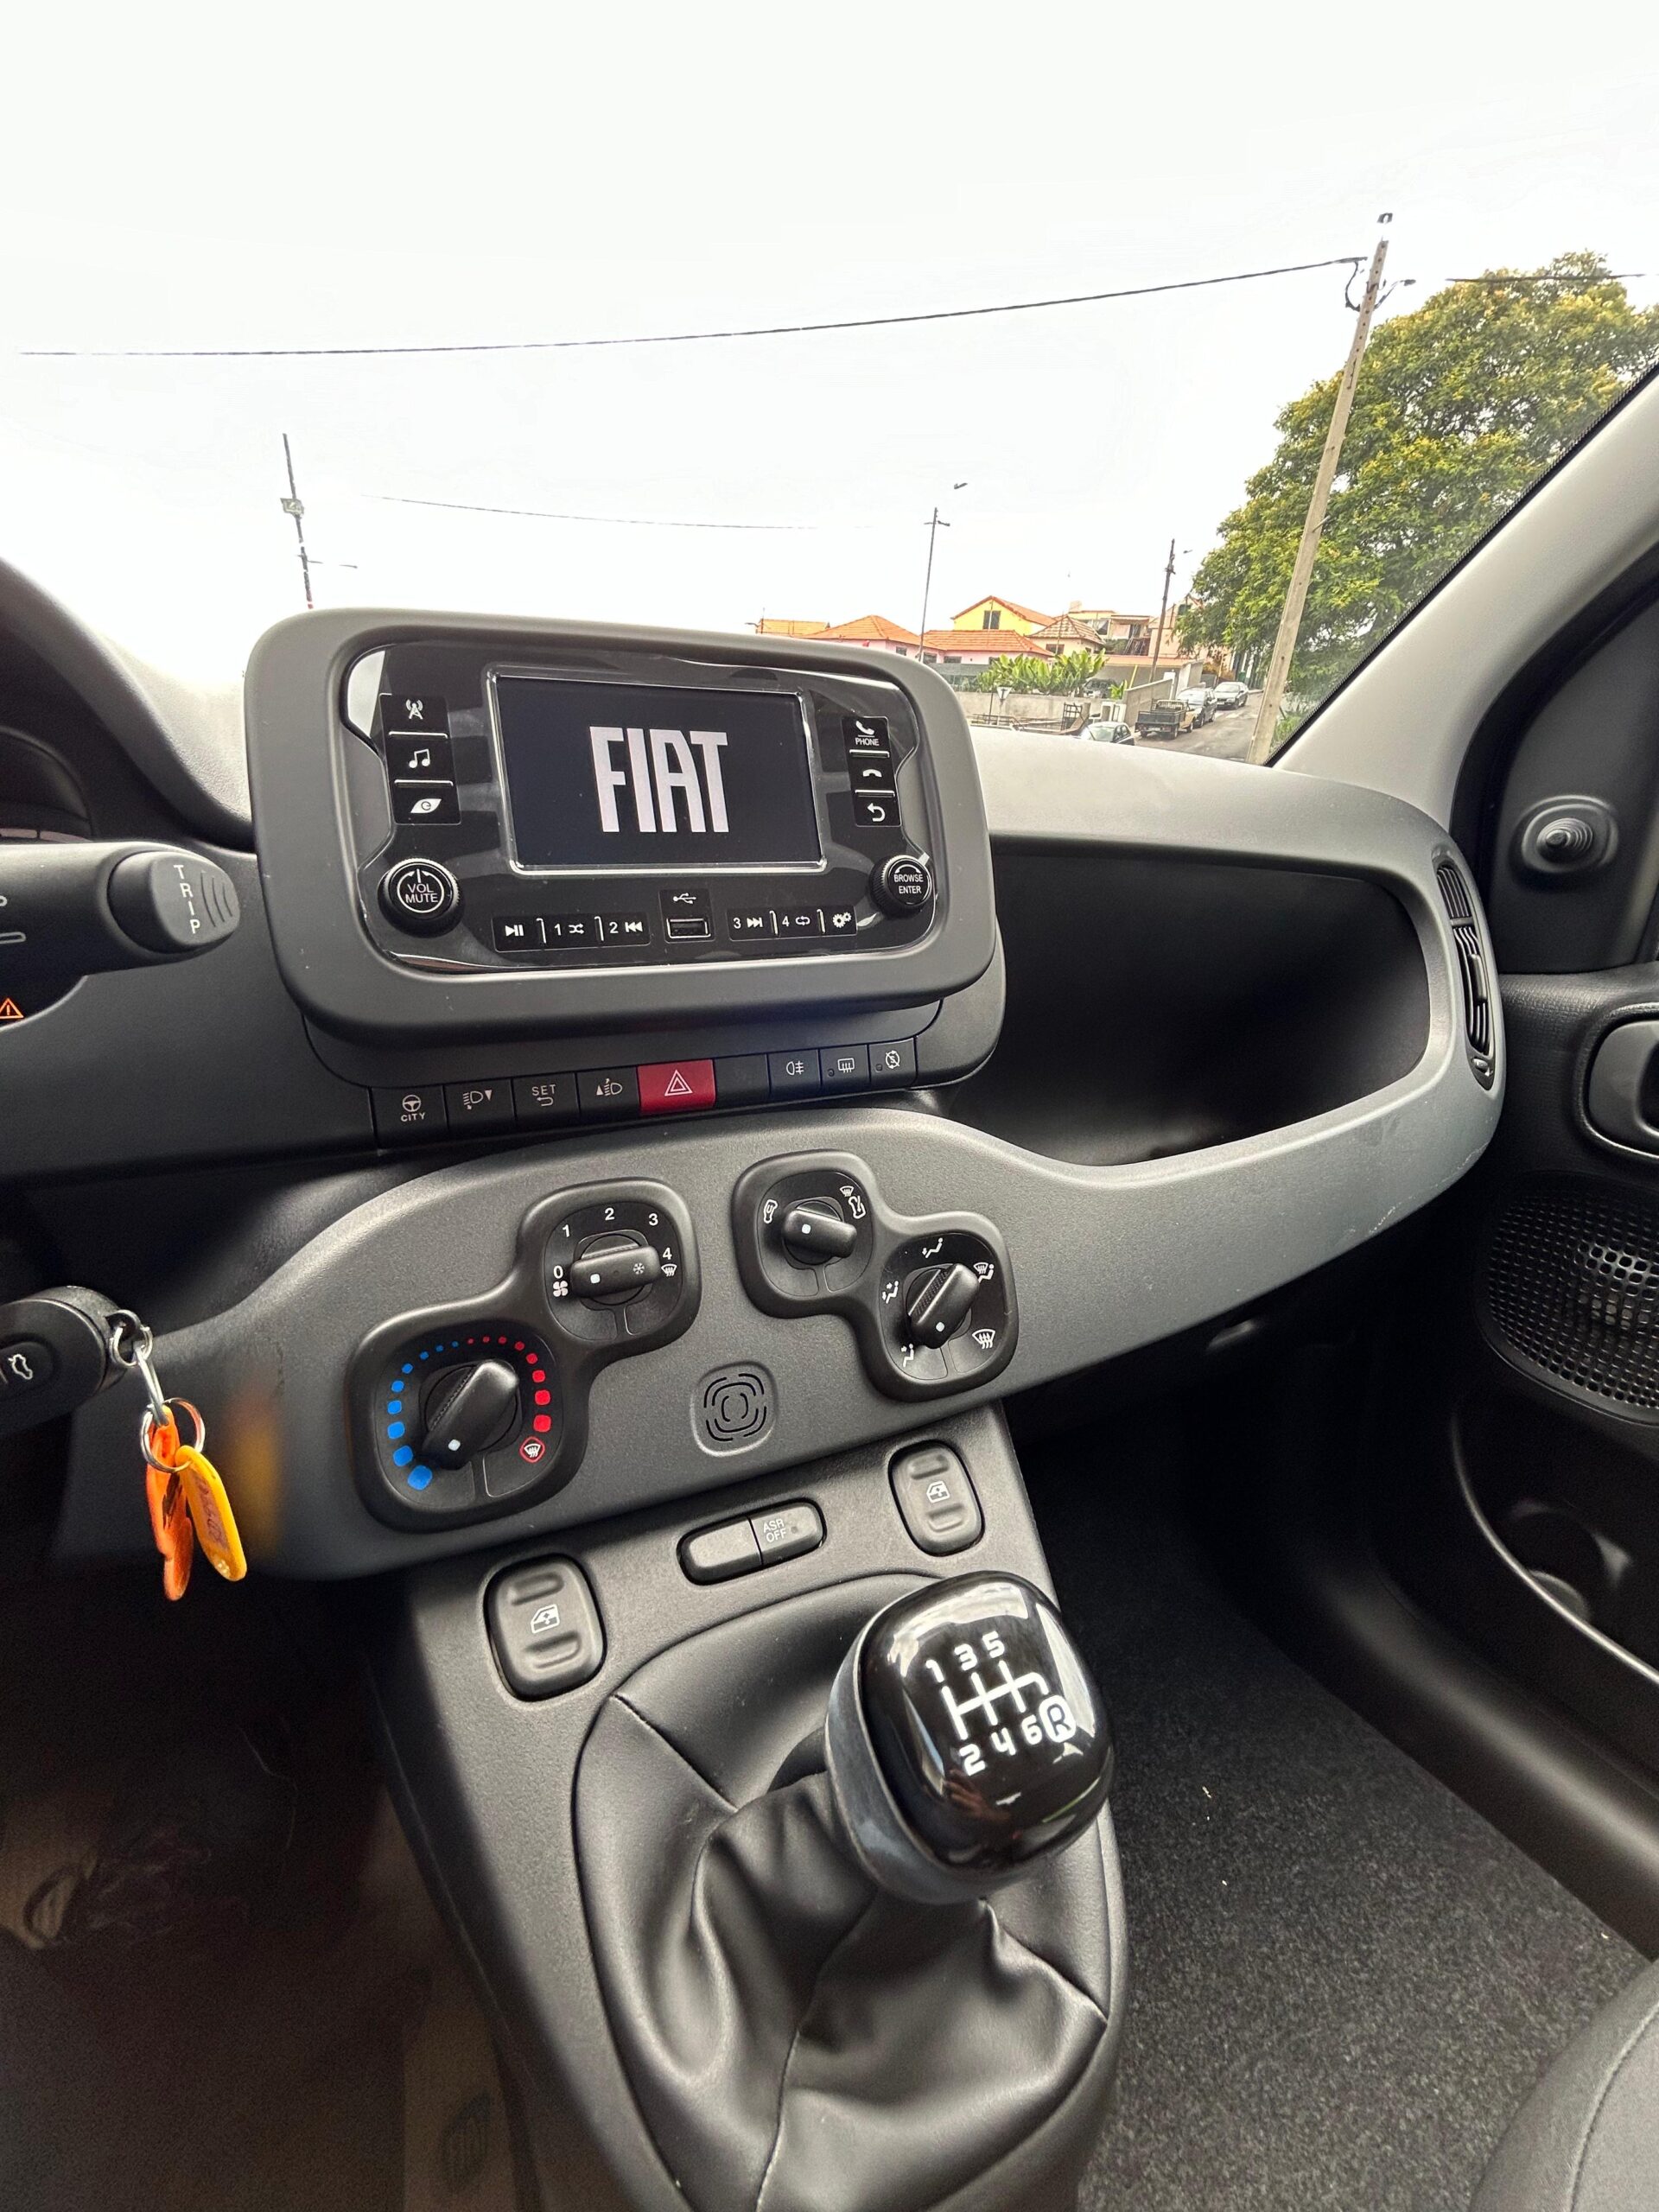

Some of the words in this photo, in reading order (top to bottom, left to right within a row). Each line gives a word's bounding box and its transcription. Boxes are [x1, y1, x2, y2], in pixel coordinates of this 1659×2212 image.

[855, 738, 880, 747] PHONE
[589, 726, 729, 832] FIAT
[893, 874, 924, 883] BROWSE
[407, 883, 435, 894] VOL
[898, 885, 922, 894] ENTER
[174, 864, 200, 934] TRIP
[404, 893, 438, 904] MUTE
[609, 922, 619, 934] 2
[733, 917, 741, 929] 3
[781, 916, 790, 927] 4
[554, 923, 562, 936] 1
[531, 1084, 556, 1096] SET
[400, 1112, 426, 1122] CITY
[605, 1207, 615, 1221] 2
[648, 1213, 658, 1226] 3
[562, 1224, 570, 1237] 1
[662, 1247, 672, 1260] 4
[763, 1518, 785, 1533] ASR
[766, 1528, 787, 1543] OFF
[925, 1659, 945, 1683] 1
[954, 1643, 977, 1671] 3
[982, 1630, 1005, 1658] 5
[958, 1743, 987, 1777] 2
[991, 1727, 1017, 1756] 4
[1020, 1714, 1043, 1745] 6
[1046, 1702, 1072, 1738] R
